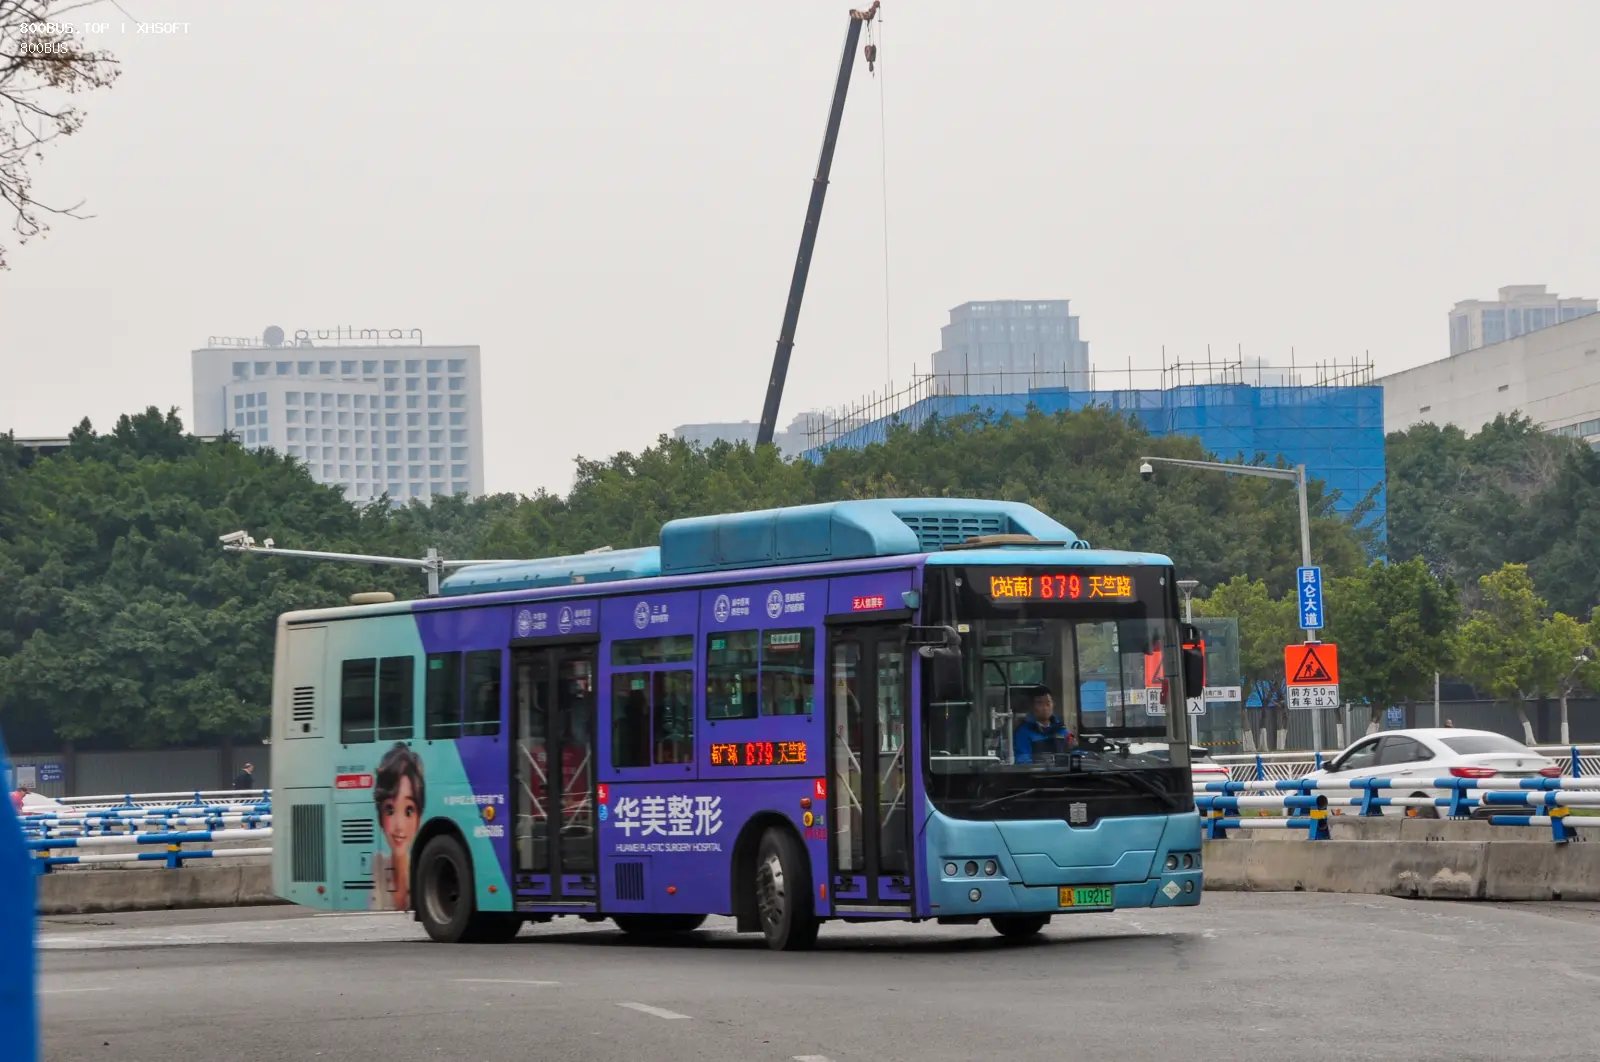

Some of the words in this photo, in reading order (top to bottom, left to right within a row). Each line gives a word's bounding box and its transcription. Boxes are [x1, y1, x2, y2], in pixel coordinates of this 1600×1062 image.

[295, 325, 422, 346] pullman
[1040, 574, 1080, 599] 879
[1089, 575, 1131, 598] 天竺路
[1302, 570, 1319, 626] 昆仑大道
[1291, 697, 1336, 706] 有车出入
[745, 741, 774, 766] 879
[614, 795, 723, 837] 华美整形
[640, 842, 665, 852] PLASTIC
[665, 842, 691, 852] SURGERY
[693, 842, 722, 852] HOSPITAL
